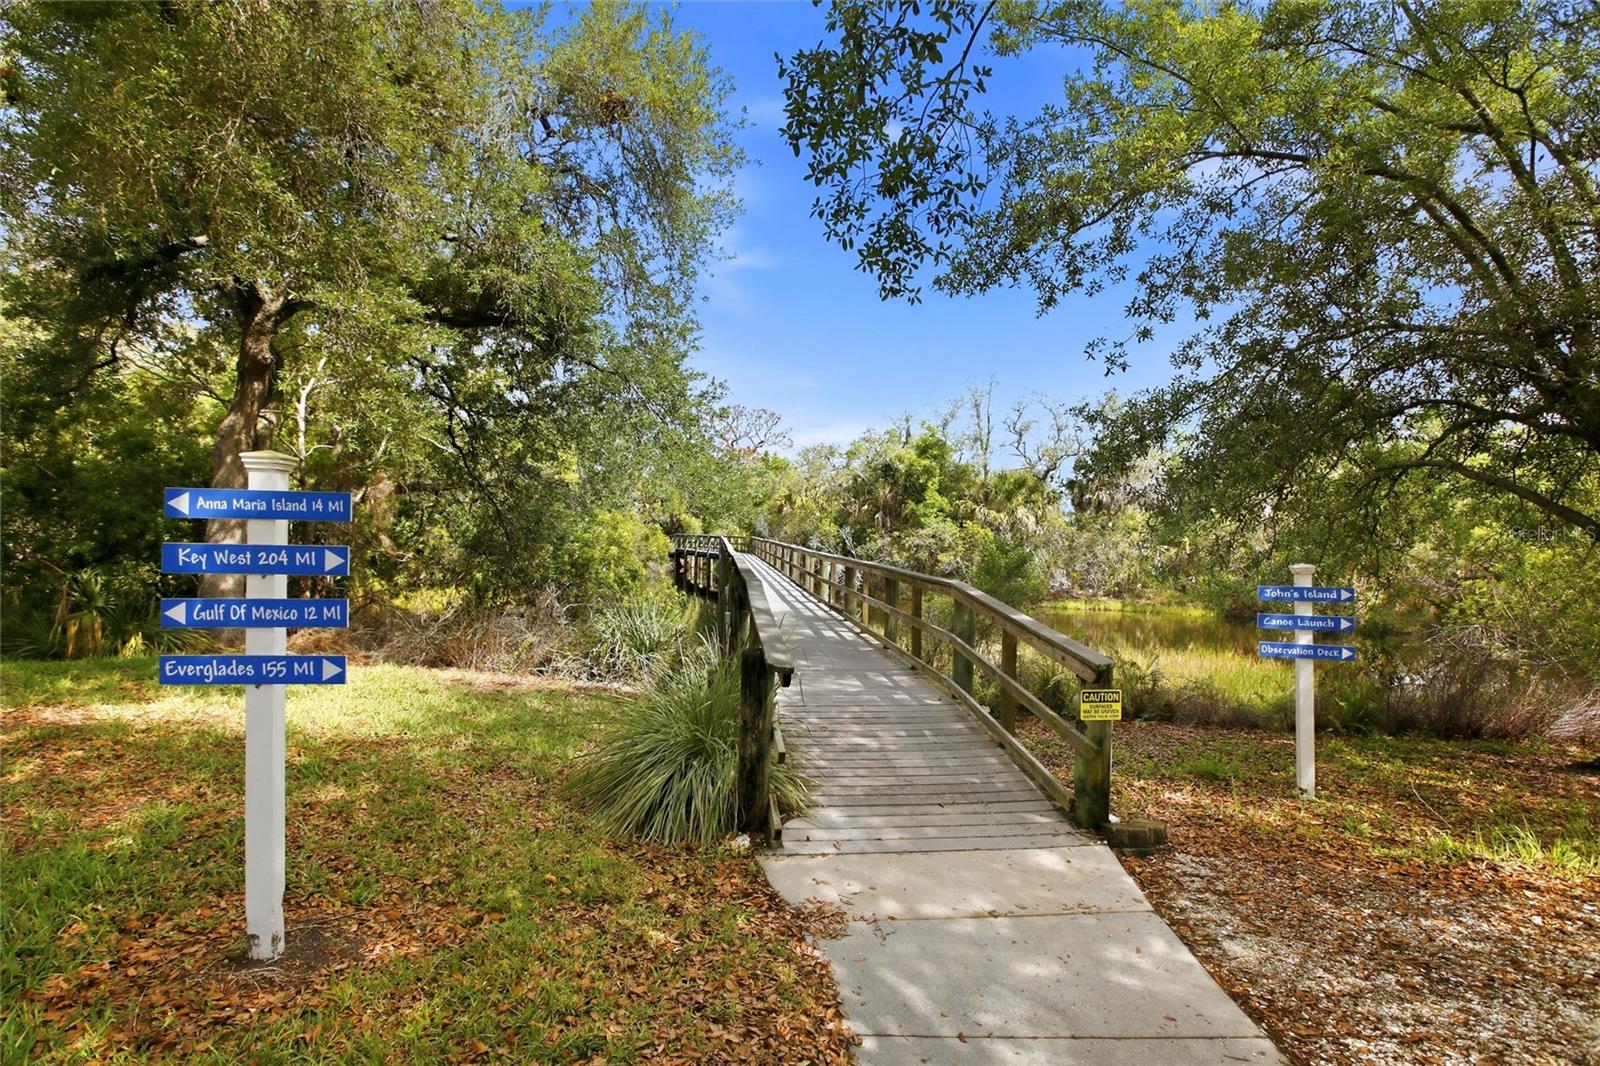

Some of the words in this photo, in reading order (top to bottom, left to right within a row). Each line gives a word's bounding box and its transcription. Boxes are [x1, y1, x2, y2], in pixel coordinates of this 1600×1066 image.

[196, 496, 227, 510] Anna
[233, 499, 266, 510] Maria
[272, 499, 306, 511] Island
[312, 499, 323, 511] 14
[328, 501, 343, 512] MI
[178, 548, 207, 569] Key
[214, 551, 250, 565] West
[258, 552, 288, 565] 204
[296, 553, 315, 565] MI
[1264, 589, 1299, 598] John's
[1304, 590, 1337, 599] Island
[194, 605, 225, 621] Gulf
[230, 605, 247, 620] Of
[252, 607, 298, 620] Mexico
[305, 607, 317, 619] 12
[323, 607, 340, 620] MI
[1264, 617, 1294, 625] Canoe
[1298, 619, 1334, 627] Launch
[1261, 645, 1313, 655] Observation
[1318, 648, 1339, 656] Deck
[165, 660, 254, 682] Everglades
[262, 662, 286, 676] 155
[294, 661, 314, 676] MI
[1084, 693, 1119, 701] CAUTION
